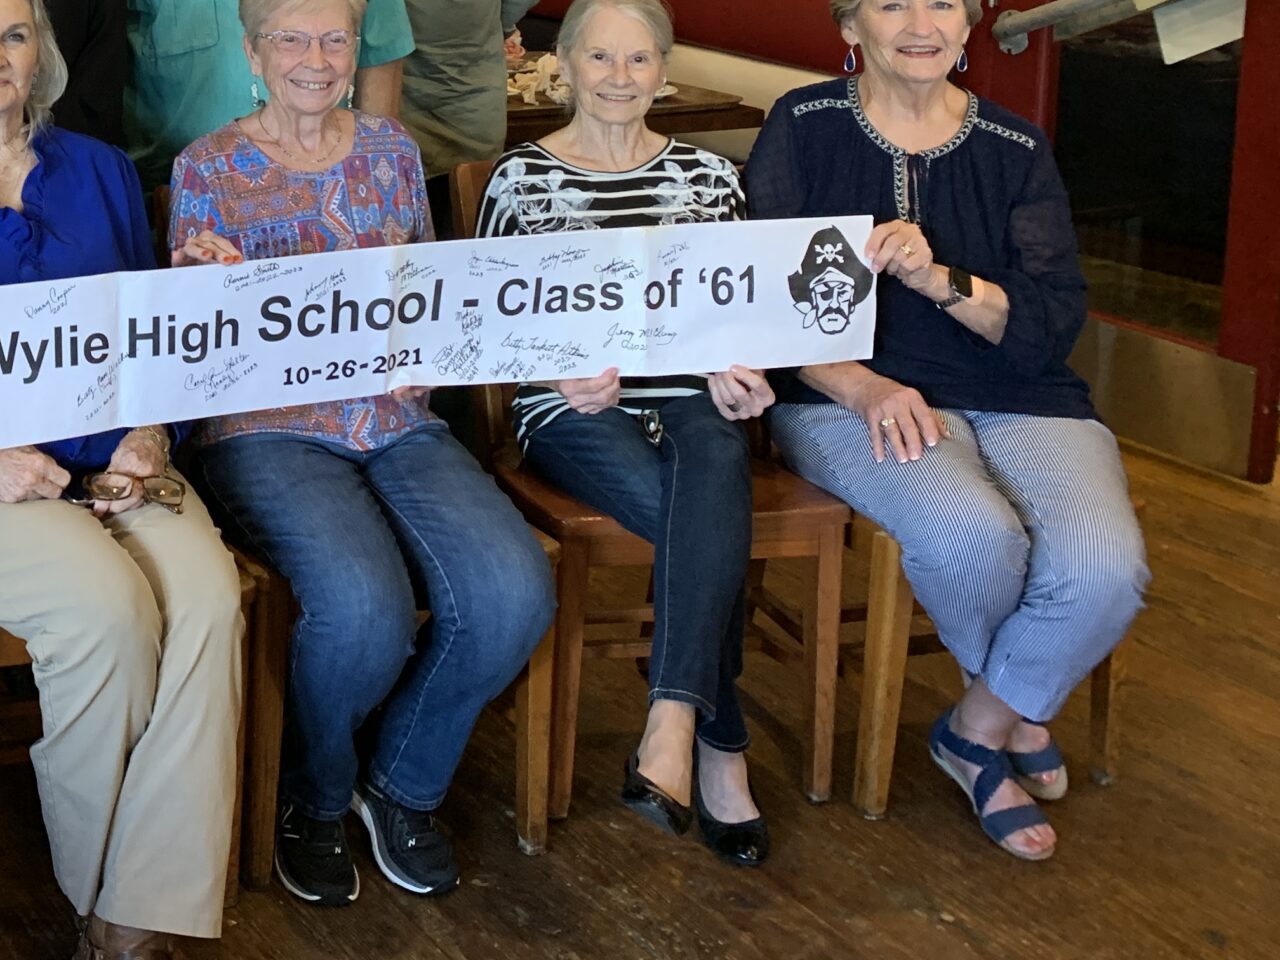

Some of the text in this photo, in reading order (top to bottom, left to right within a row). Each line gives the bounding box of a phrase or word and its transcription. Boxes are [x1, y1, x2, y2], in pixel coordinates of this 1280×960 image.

[127, 309, 240, 364] High
[258, 277, 443, 342] School
[497, 277, 624, 316] Class
[643, 267, 683, 310] of
[282, 348, 424, 387] 10-26-2021
